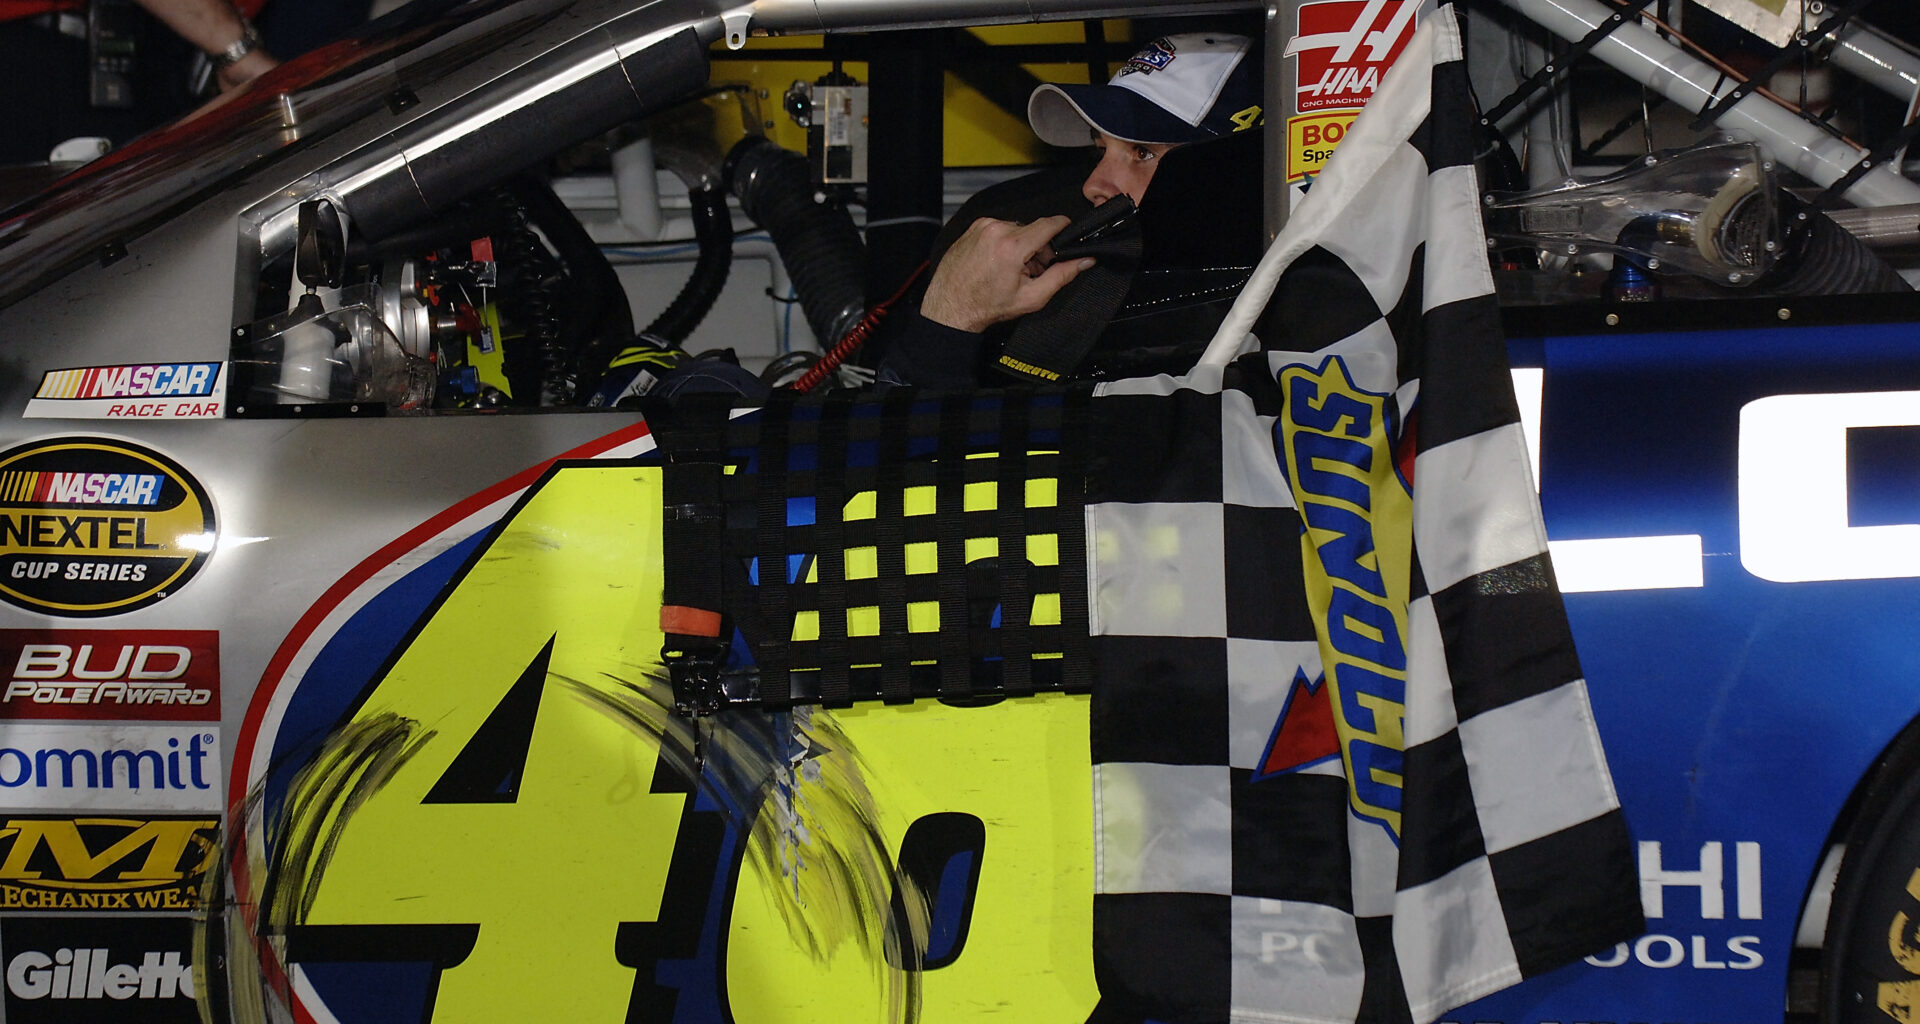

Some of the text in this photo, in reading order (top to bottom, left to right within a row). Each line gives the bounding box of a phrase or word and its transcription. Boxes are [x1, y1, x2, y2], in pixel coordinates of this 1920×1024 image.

[1298, 66, 1390, 96] HAA
[1230, 105, 1264, 132] 4
[1302, 121, 1353, 147] BO
[92, 364, 210, 396] NASCAR
[107, 402, 219, 417] RACE CAR
[47, 473, 156, 504] NASCAR
[0, 514, 159, 550] NEXTEL
[11, 561, 147, 582] CUP SERIES
[13, 644, 192, 680] BUD
[0, 885, 200, 909] ECHANIX WEA
